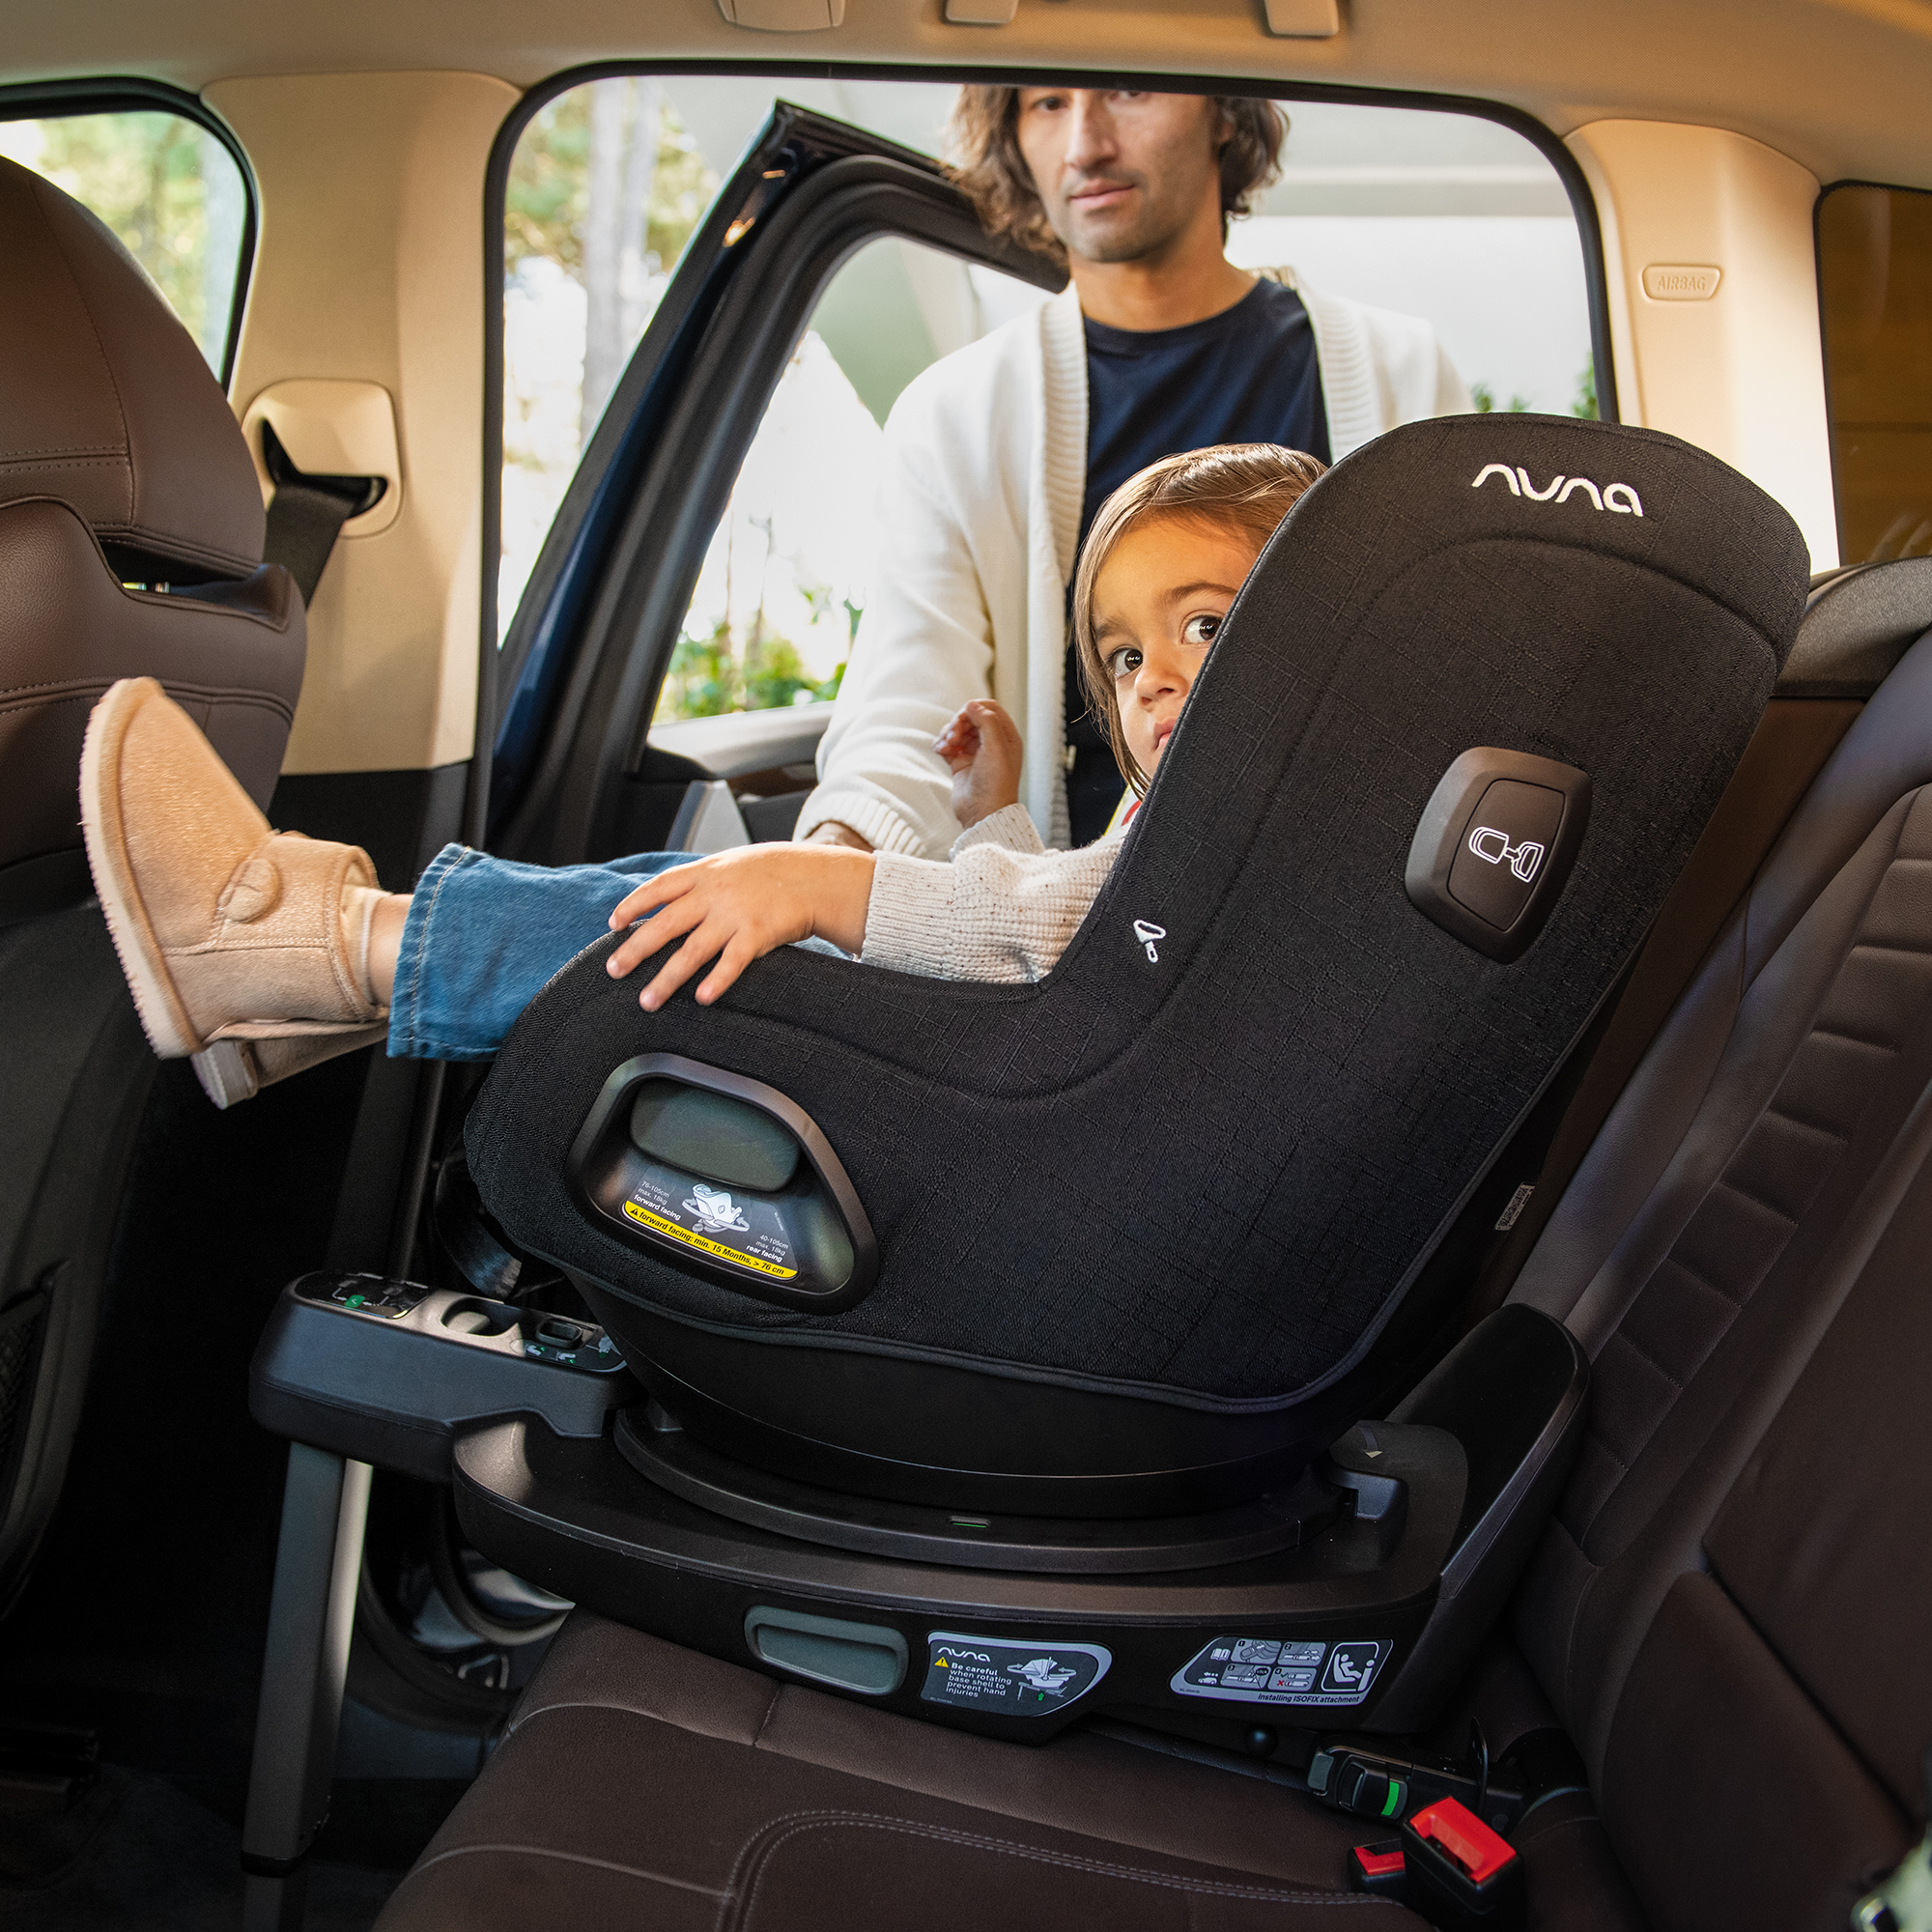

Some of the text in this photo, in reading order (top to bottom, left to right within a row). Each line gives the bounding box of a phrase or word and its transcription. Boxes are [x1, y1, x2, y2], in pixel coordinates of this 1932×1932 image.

[1657, 275, 1707, 291] AIRBAG
[1471, 463, 1644, 518] nuna
[638, 1187, 668, 1206] max. 18kg
[641, 1180, 670, 1198] 76-105cm
[634, 1194, 682, 1221] forward facing
[639, 1211, 668, 1231] forward
[668, 1225, 695, 1242] facing:
[694, 1237, 710, 1249] min.
[713, 1243, 722, 1253] 15
[723, 1247, 752, 1265] Months,
[761, 1262, 771, 1271] 76
[755, 1240, 786, 1257] max. 18kg
[759, 1235, 789, 1250] 40-105cm
[746, 1244, 783, 1264] rear facing
[937, 1646, 991, 1662] nuna
[950, 1669, 1012, 1686] when rotating
[952, 1662, 998, 1676] Be careful
[947, 1681, 1007, 1696] prevent hand
[948, 1674, 970, 1684] base
[972, 1679, 994, 1689] shell
[1293, 1694, 1320, 1703] ISOFIX
